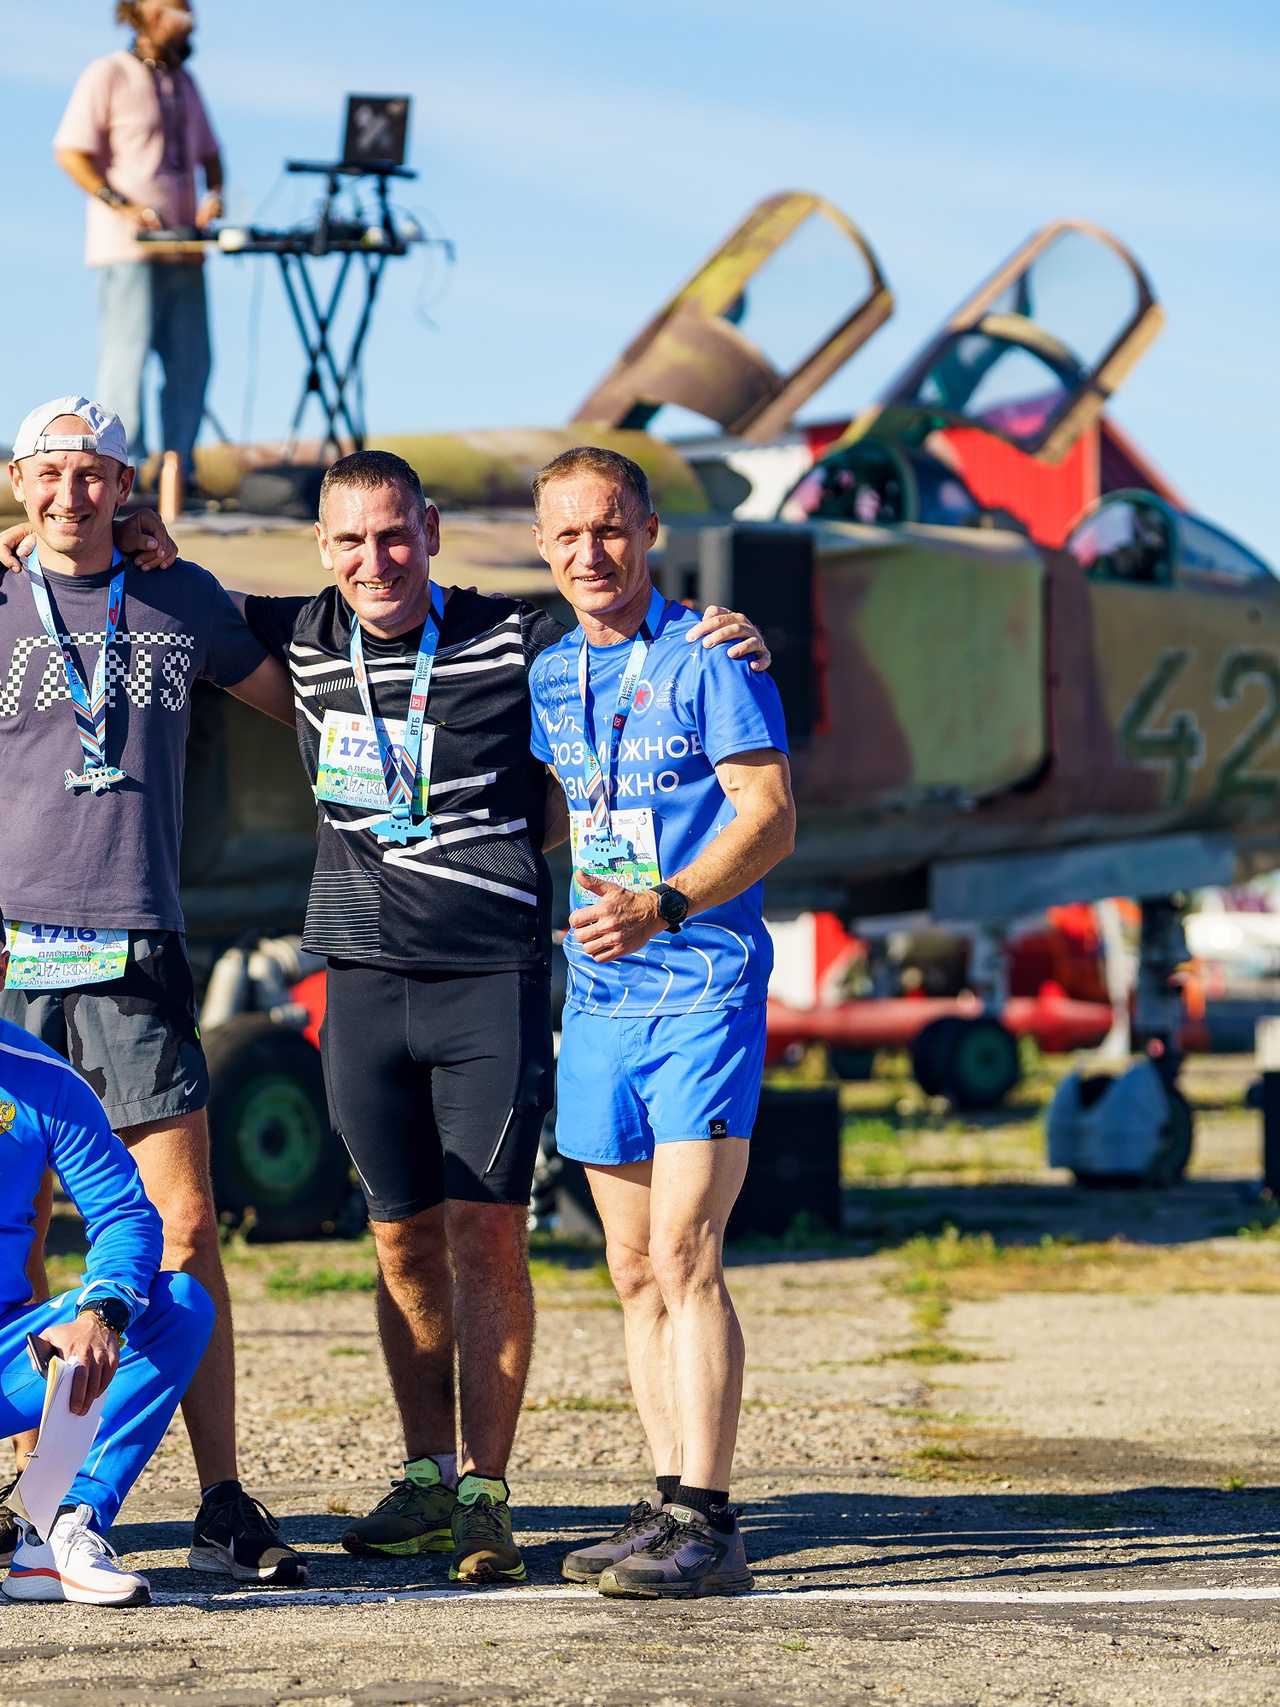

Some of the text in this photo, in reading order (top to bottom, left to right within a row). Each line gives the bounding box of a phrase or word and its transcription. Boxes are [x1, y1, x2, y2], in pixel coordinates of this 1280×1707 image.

[410, 716, 421, 736] ВТБ
[1117, 646, 1280, 810] 42
[345, 775, 365, 794] 17
[31, 924, 97, 943] 1716
[38, 961, 93, 976] 17 КМ
[673, 1509, 690, 1521] NIKE
